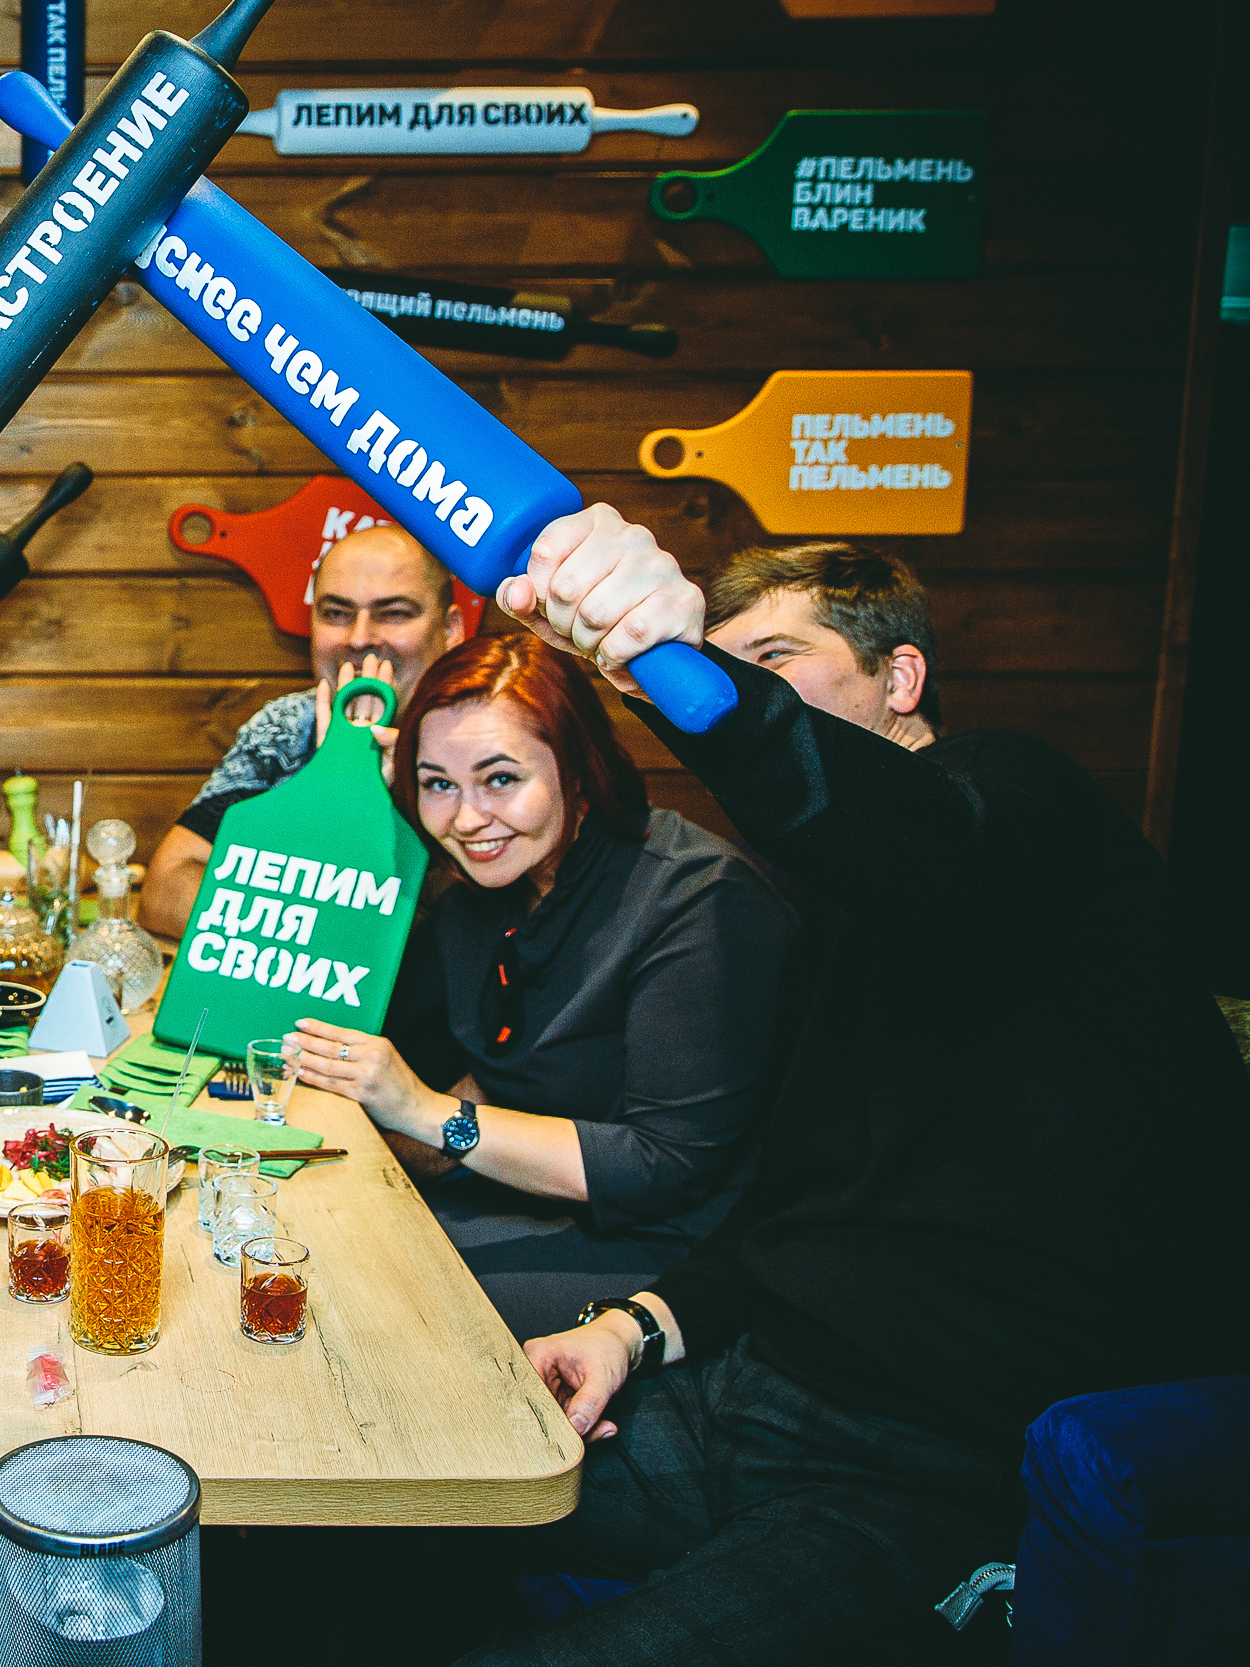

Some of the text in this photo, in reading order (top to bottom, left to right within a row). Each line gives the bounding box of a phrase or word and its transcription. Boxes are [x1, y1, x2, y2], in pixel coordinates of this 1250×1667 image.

[293, 101, 588, 130] ЛЕПИМ ДЛЯ СВОИХ
[794, 156, 974, 183] #ПЕЛЬМЕНЬ
[793, 181, 874, 206] БЛИН
[791, 206, 927, 233] ВАРЕНИК
[434, 298, 566, 333] пельмень
[264, 323, 361, 427] чем
[346, 409, 495, 547] дома
[792, 412, 956, 439] ПЕЛЬМЕНЬ
[790, 439, 849, 465] ТАК
[789, 463, 953, 491] ПЕЛЬМЕНЬ
[214, 844, 402, 916] ЛЕПИМ
[196, 887, 318, 946] ДЛЯ
[187, 931, 370, 1007] СВОИХ
